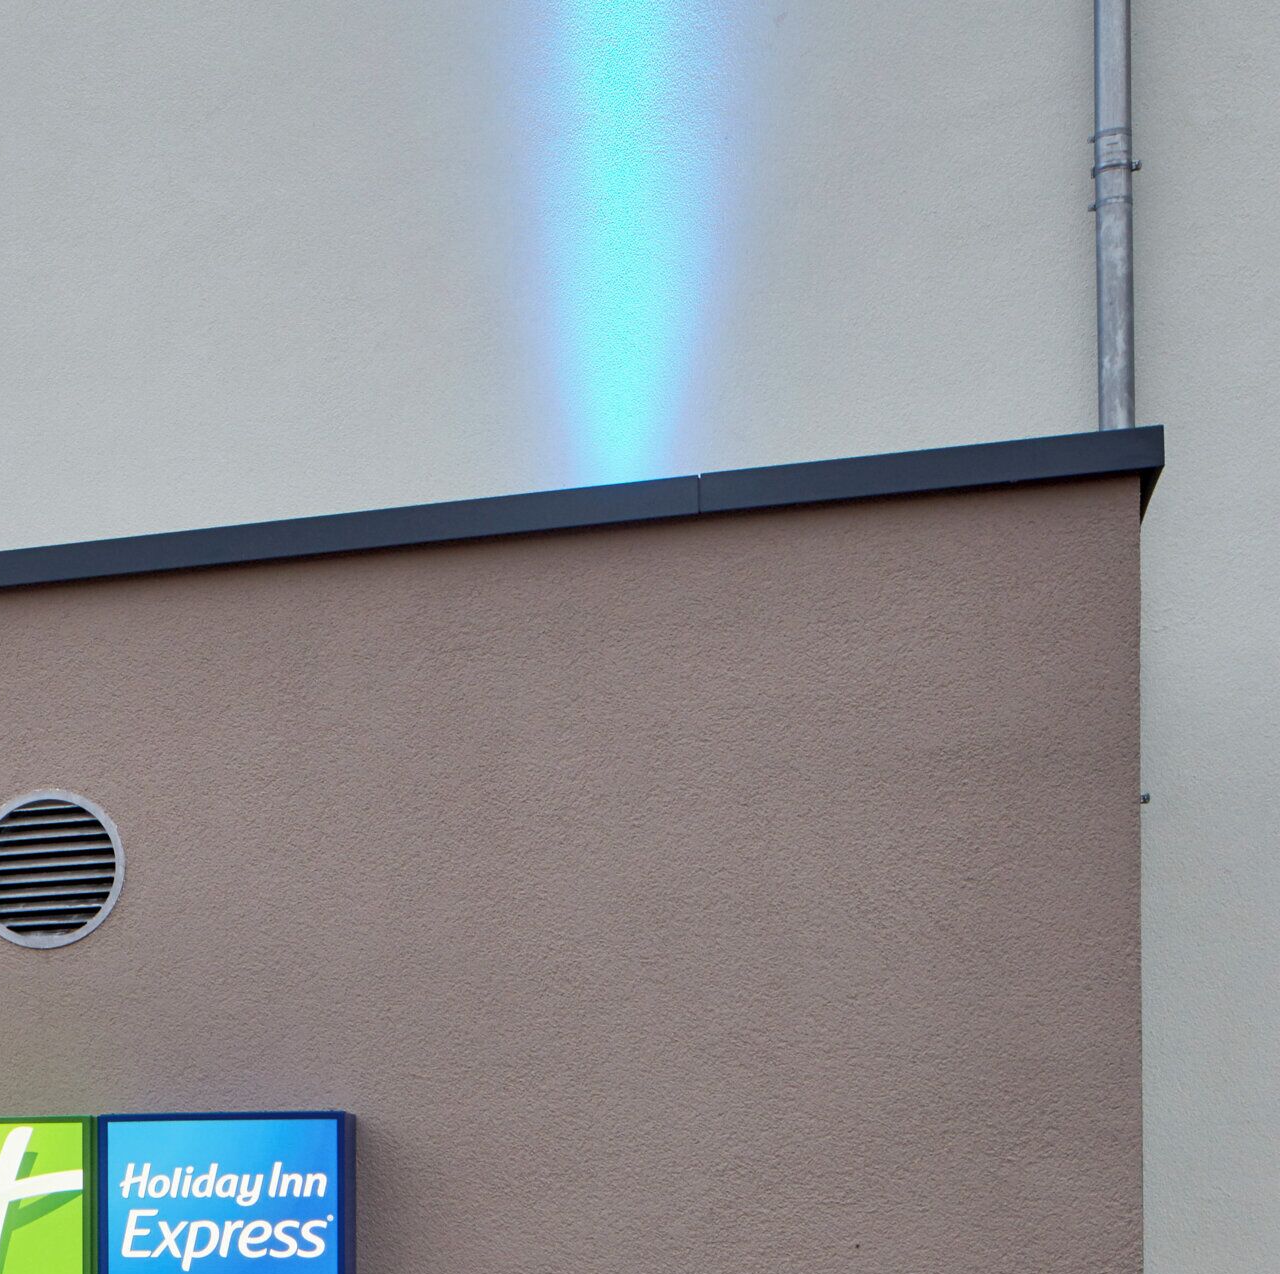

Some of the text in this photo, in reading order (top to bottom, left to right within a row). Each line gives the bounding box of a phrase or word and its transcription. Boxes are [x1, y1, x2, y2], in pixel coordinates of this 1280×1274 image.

[120, 1162, 327, 1206] Holiday Inn
[121, 1208, 327, 1271] Express
